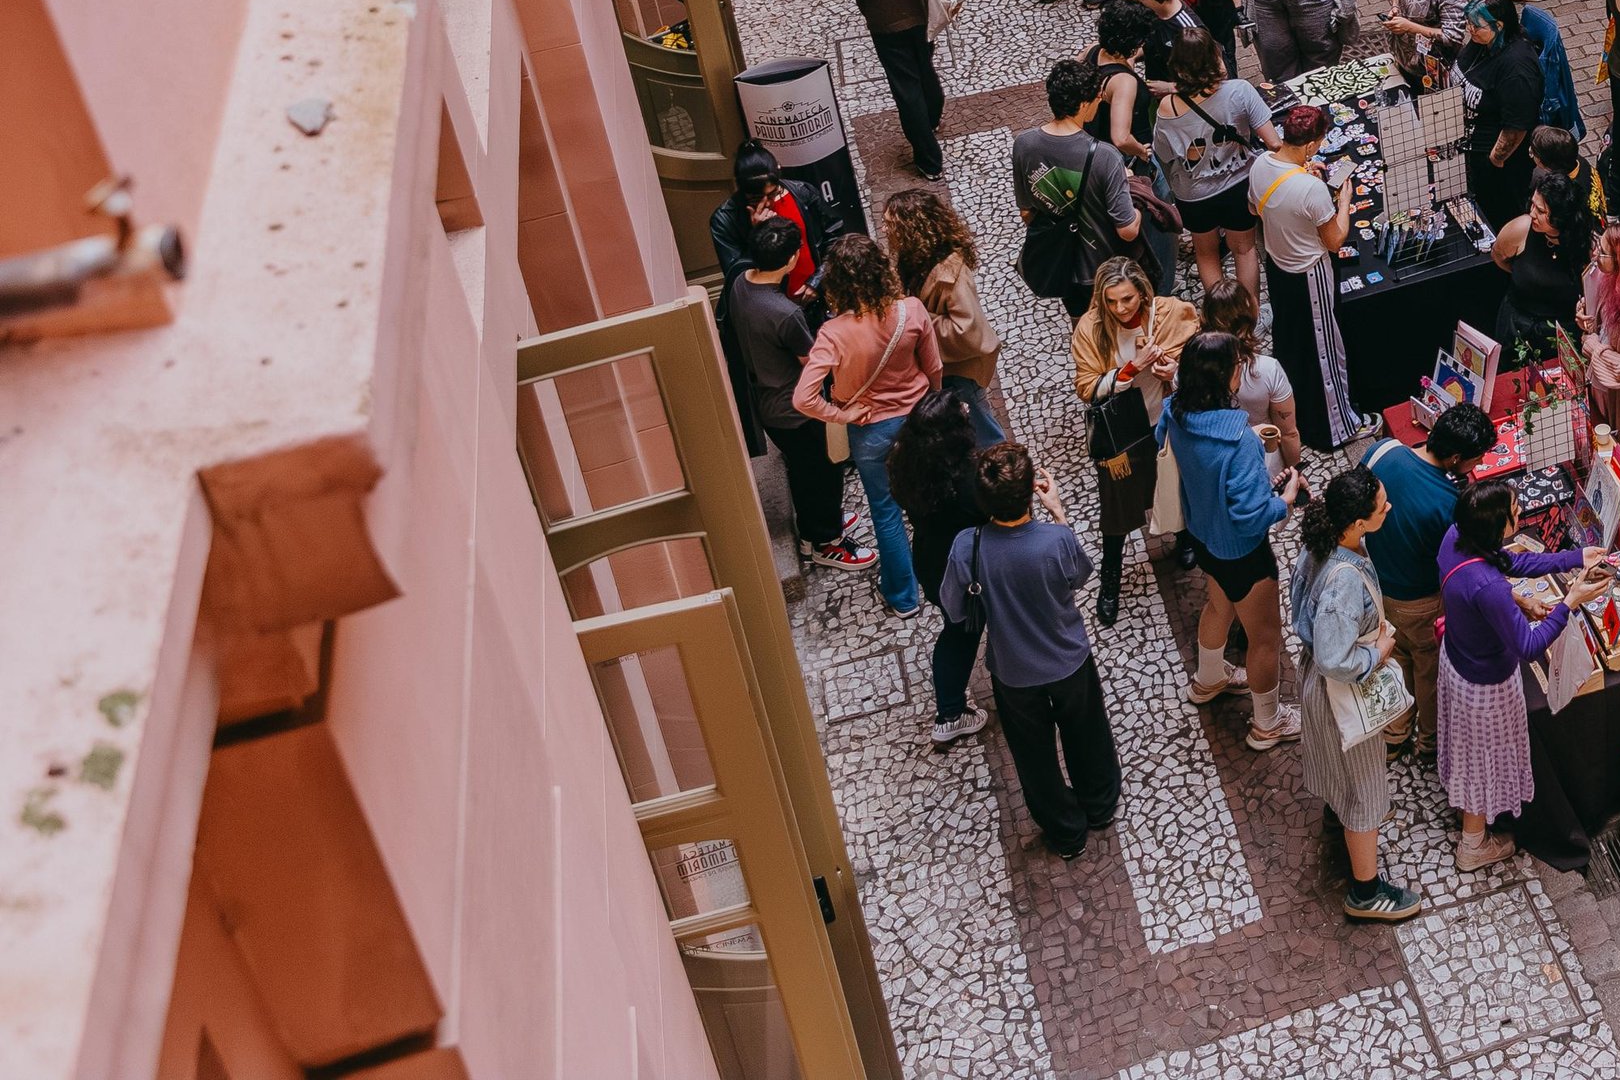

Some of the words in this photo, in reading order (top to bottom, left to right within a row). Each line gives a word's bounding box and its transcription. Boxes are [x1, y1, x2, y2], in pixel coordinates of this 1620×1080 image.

[755, 125, 785, 140] PAULO
[790, 110, 833, 137] AMORIM
[758, 104, 825, 125] CINEMATECA
